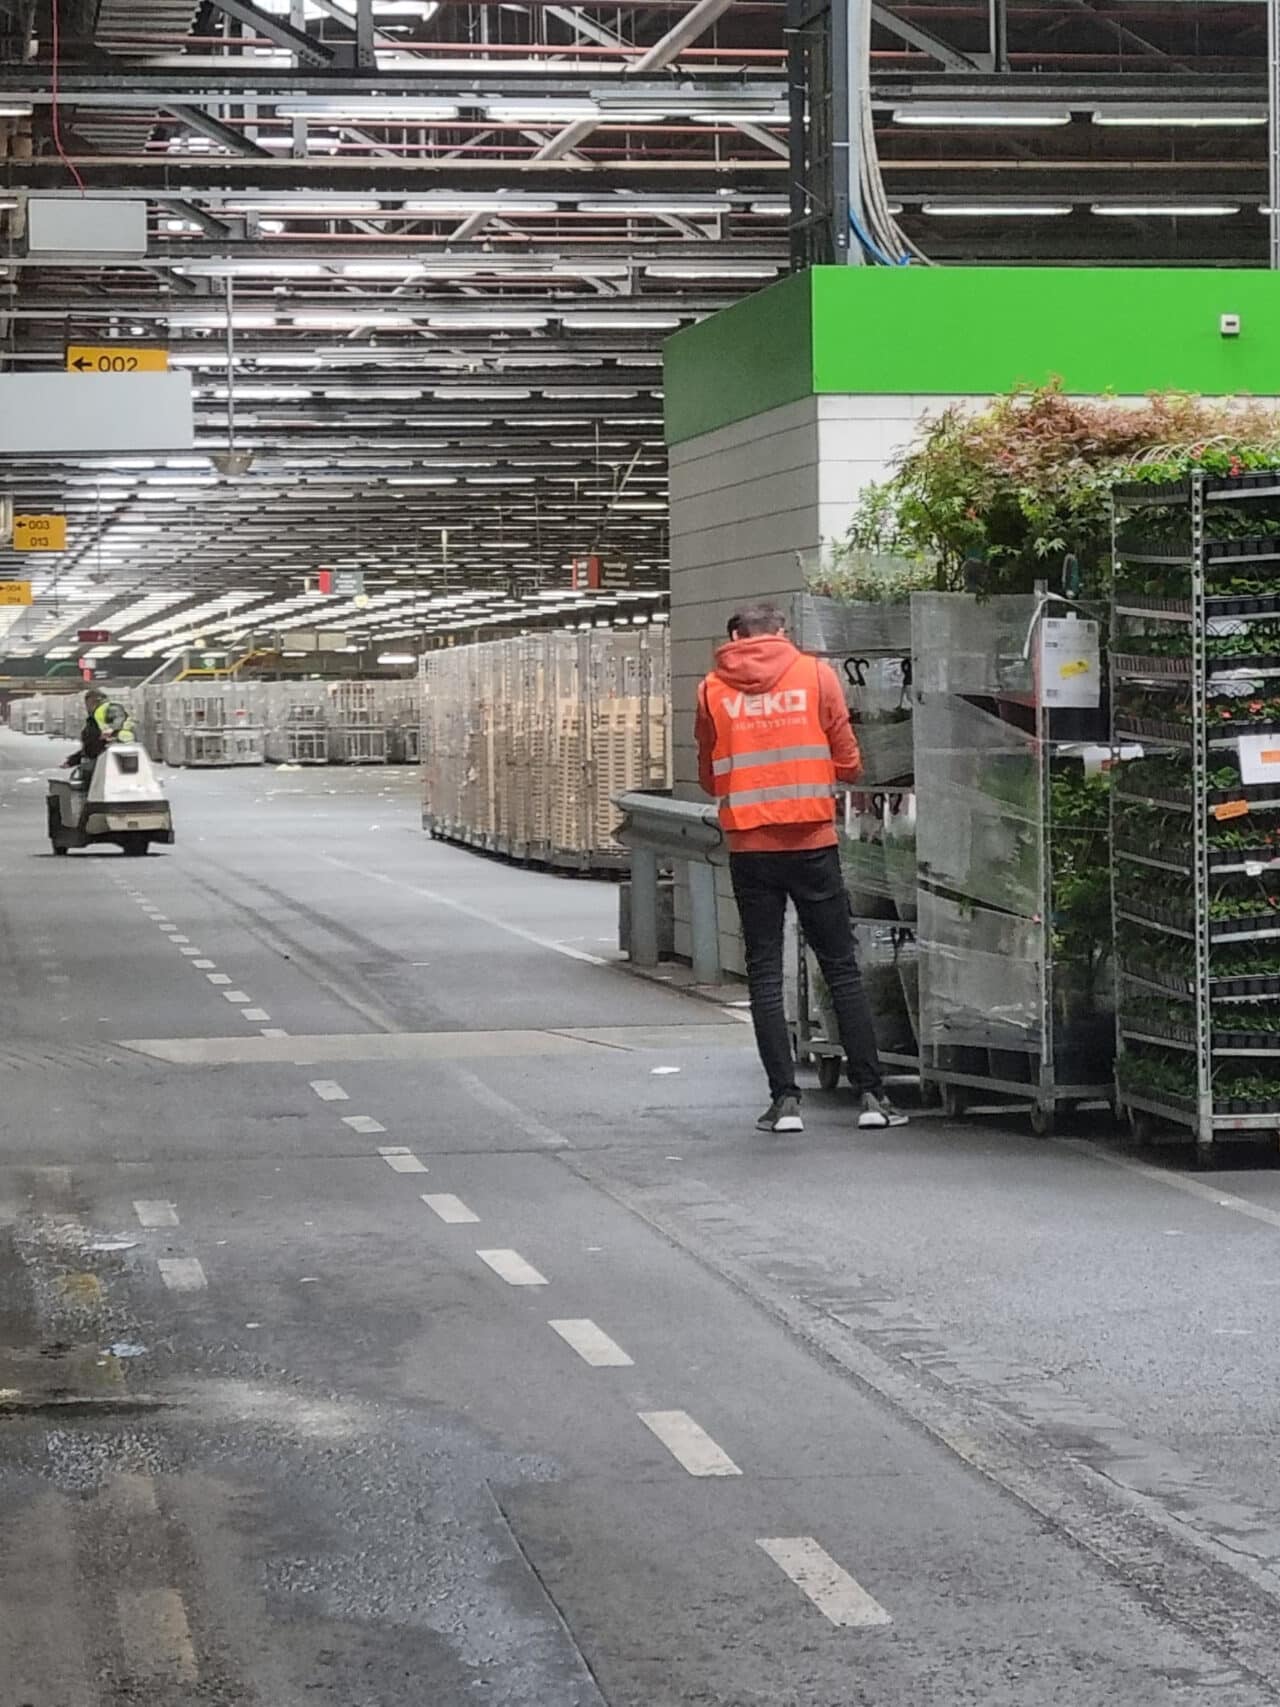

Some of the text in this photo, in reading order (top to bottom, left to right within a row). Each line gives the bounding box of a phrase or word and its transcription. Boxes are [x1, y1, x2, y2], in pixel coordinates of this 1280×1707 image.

[98, 356, 138, 372] 002
[28, 520, 50, 530] 003
[30, 537, 49, 547] 013
[723, 689, 807, 719] VEKO
